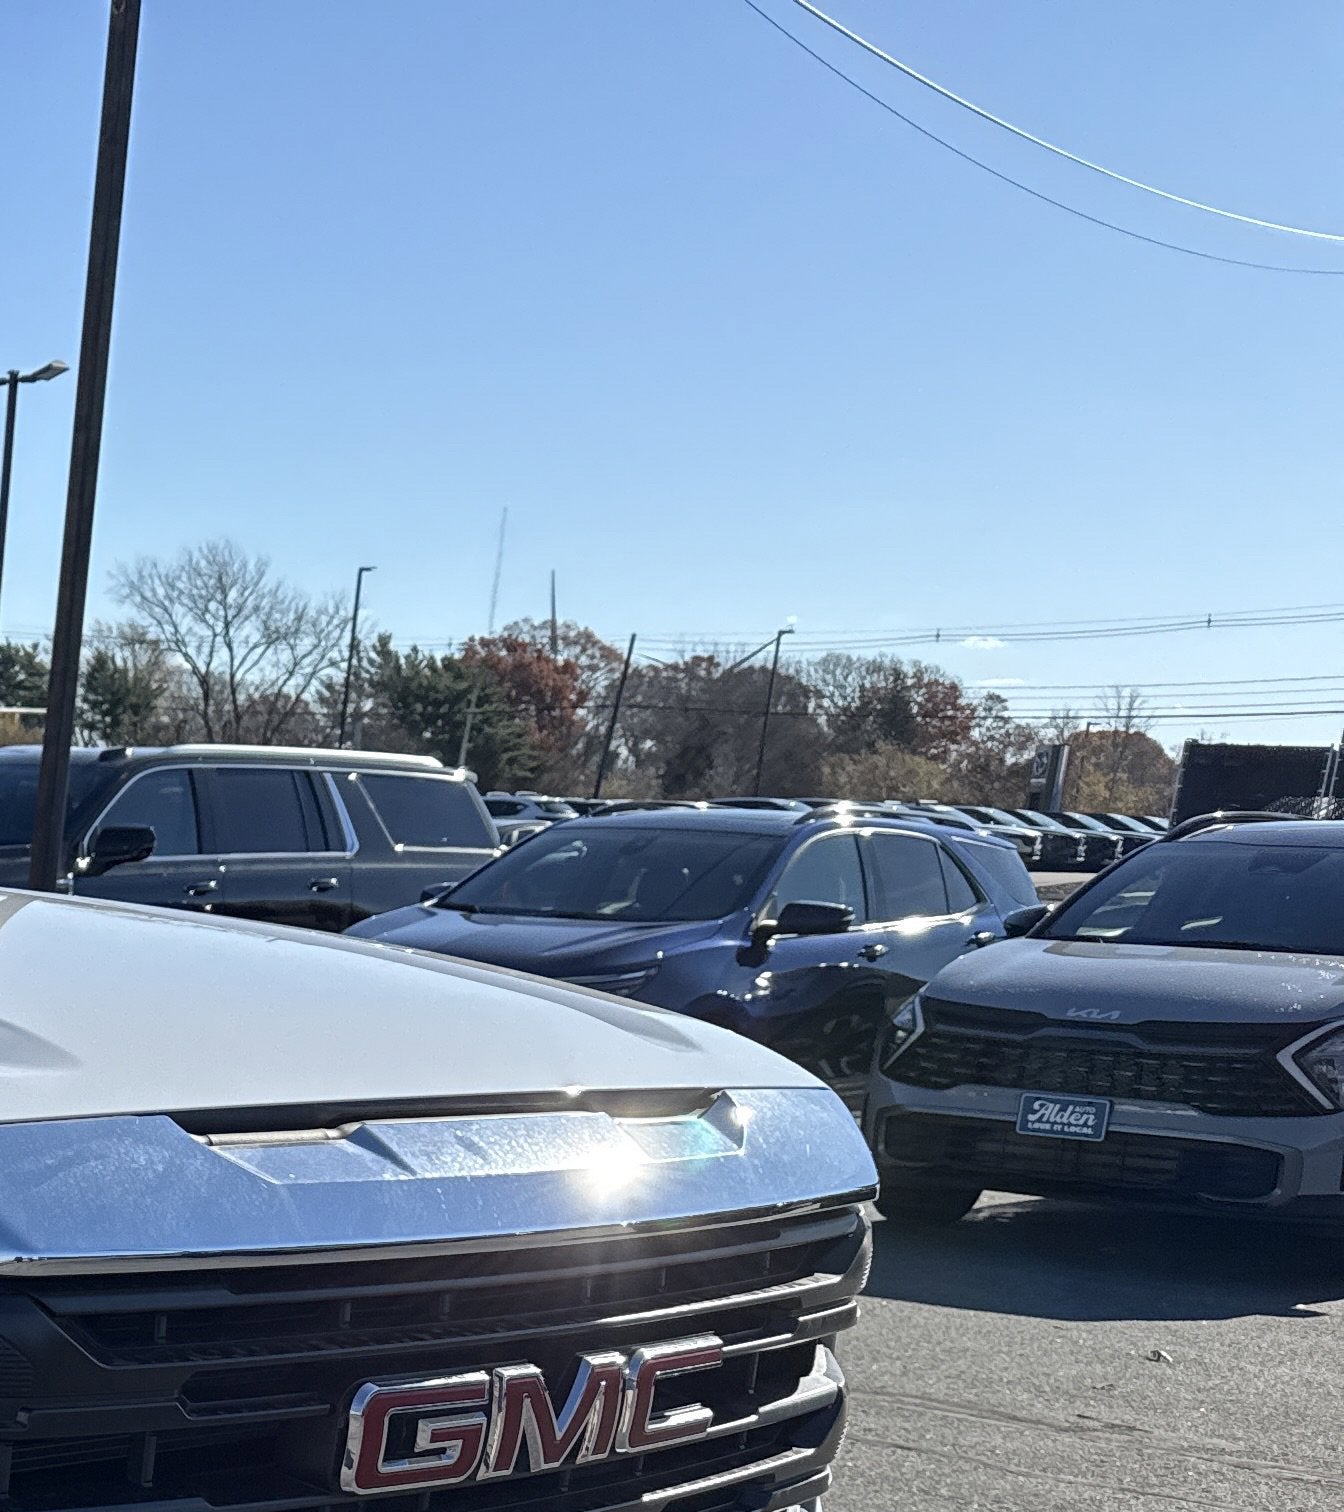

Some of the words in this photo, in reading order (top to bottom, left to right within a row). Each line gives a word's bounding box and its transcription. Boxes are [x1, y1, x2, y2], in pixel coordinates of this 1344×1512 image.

[1027, 1100, 1098, 1126] Alden
[1073, 1105, 1097, 1114] AUTO
[1027, 1121, 1052, 1131] LOVE
[1053, 1123, 1063, 1132] IT
[1064, 1125, 1094, 1135] LOCAL
[340, 1331, 725, 1496] GMC
